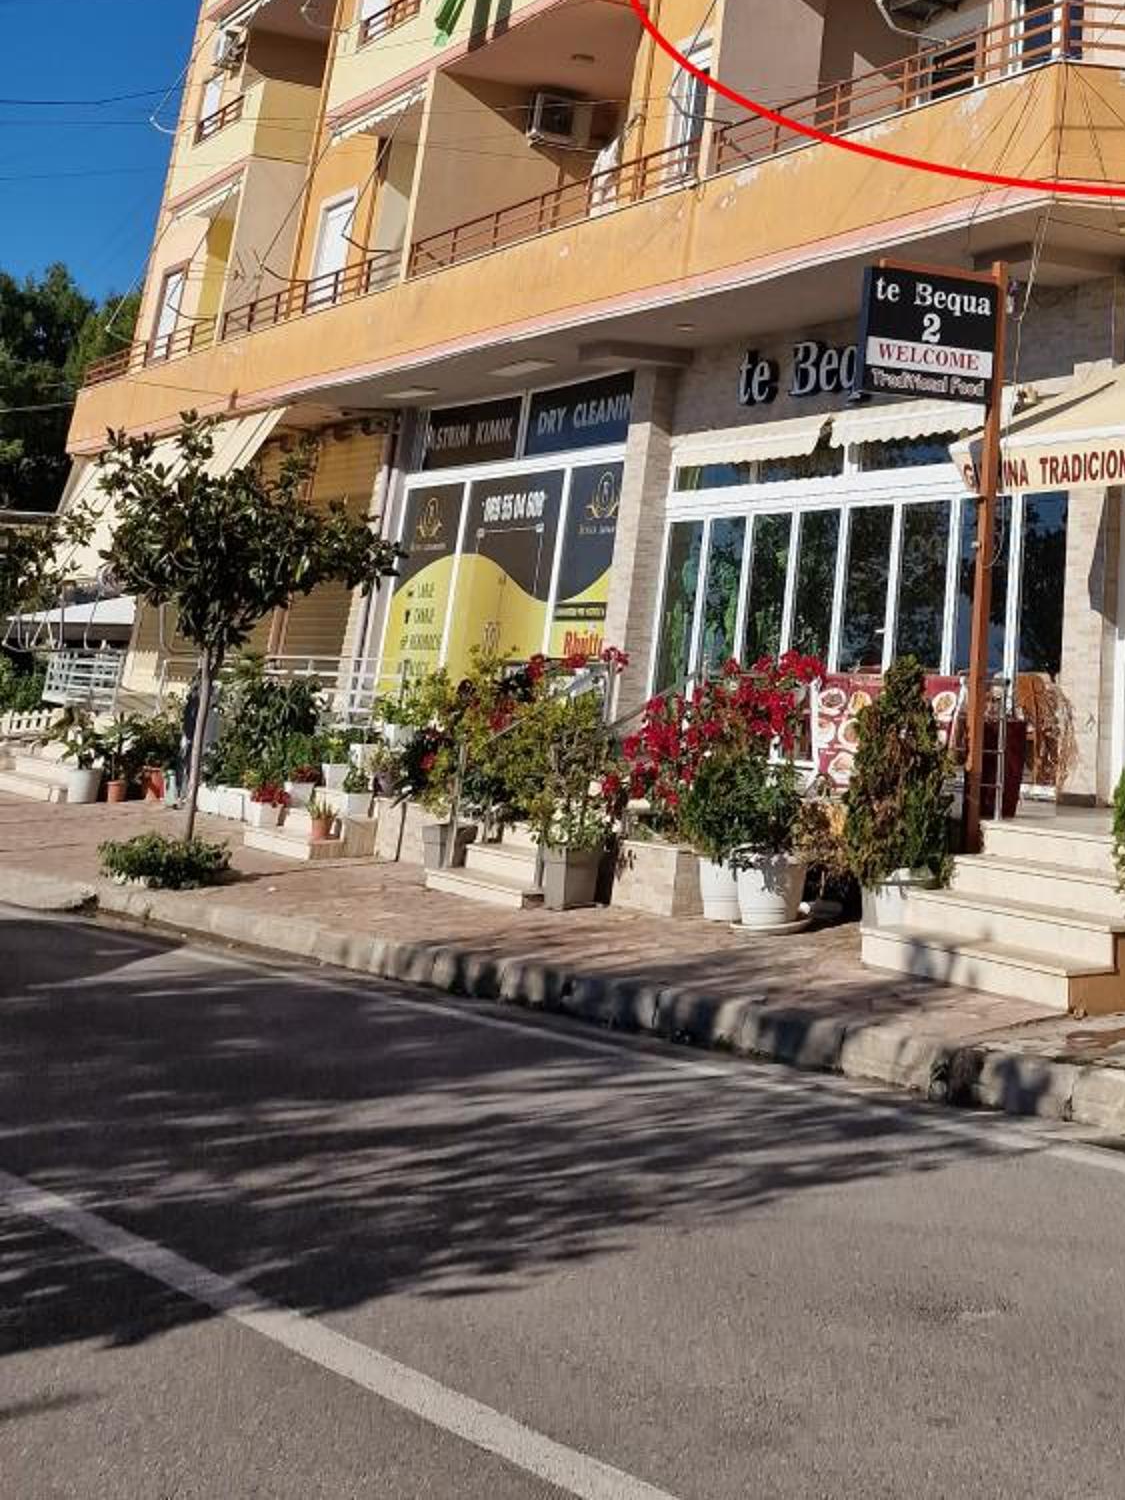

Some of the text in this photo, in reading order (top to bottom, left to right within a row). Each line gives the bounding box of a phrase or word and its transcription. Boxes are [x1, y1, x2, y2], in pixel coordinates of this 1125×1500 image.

[876, 276, 992, 316] te Bequa
[922, 313, 941, 343] 2
[738, 340, 862, 402] te Beq
[879, 343, 979, 370] WELCOME
[871, 368, 985, 397] Traditional Food
[537, 393, 632, 436] DRY CLEANIN
